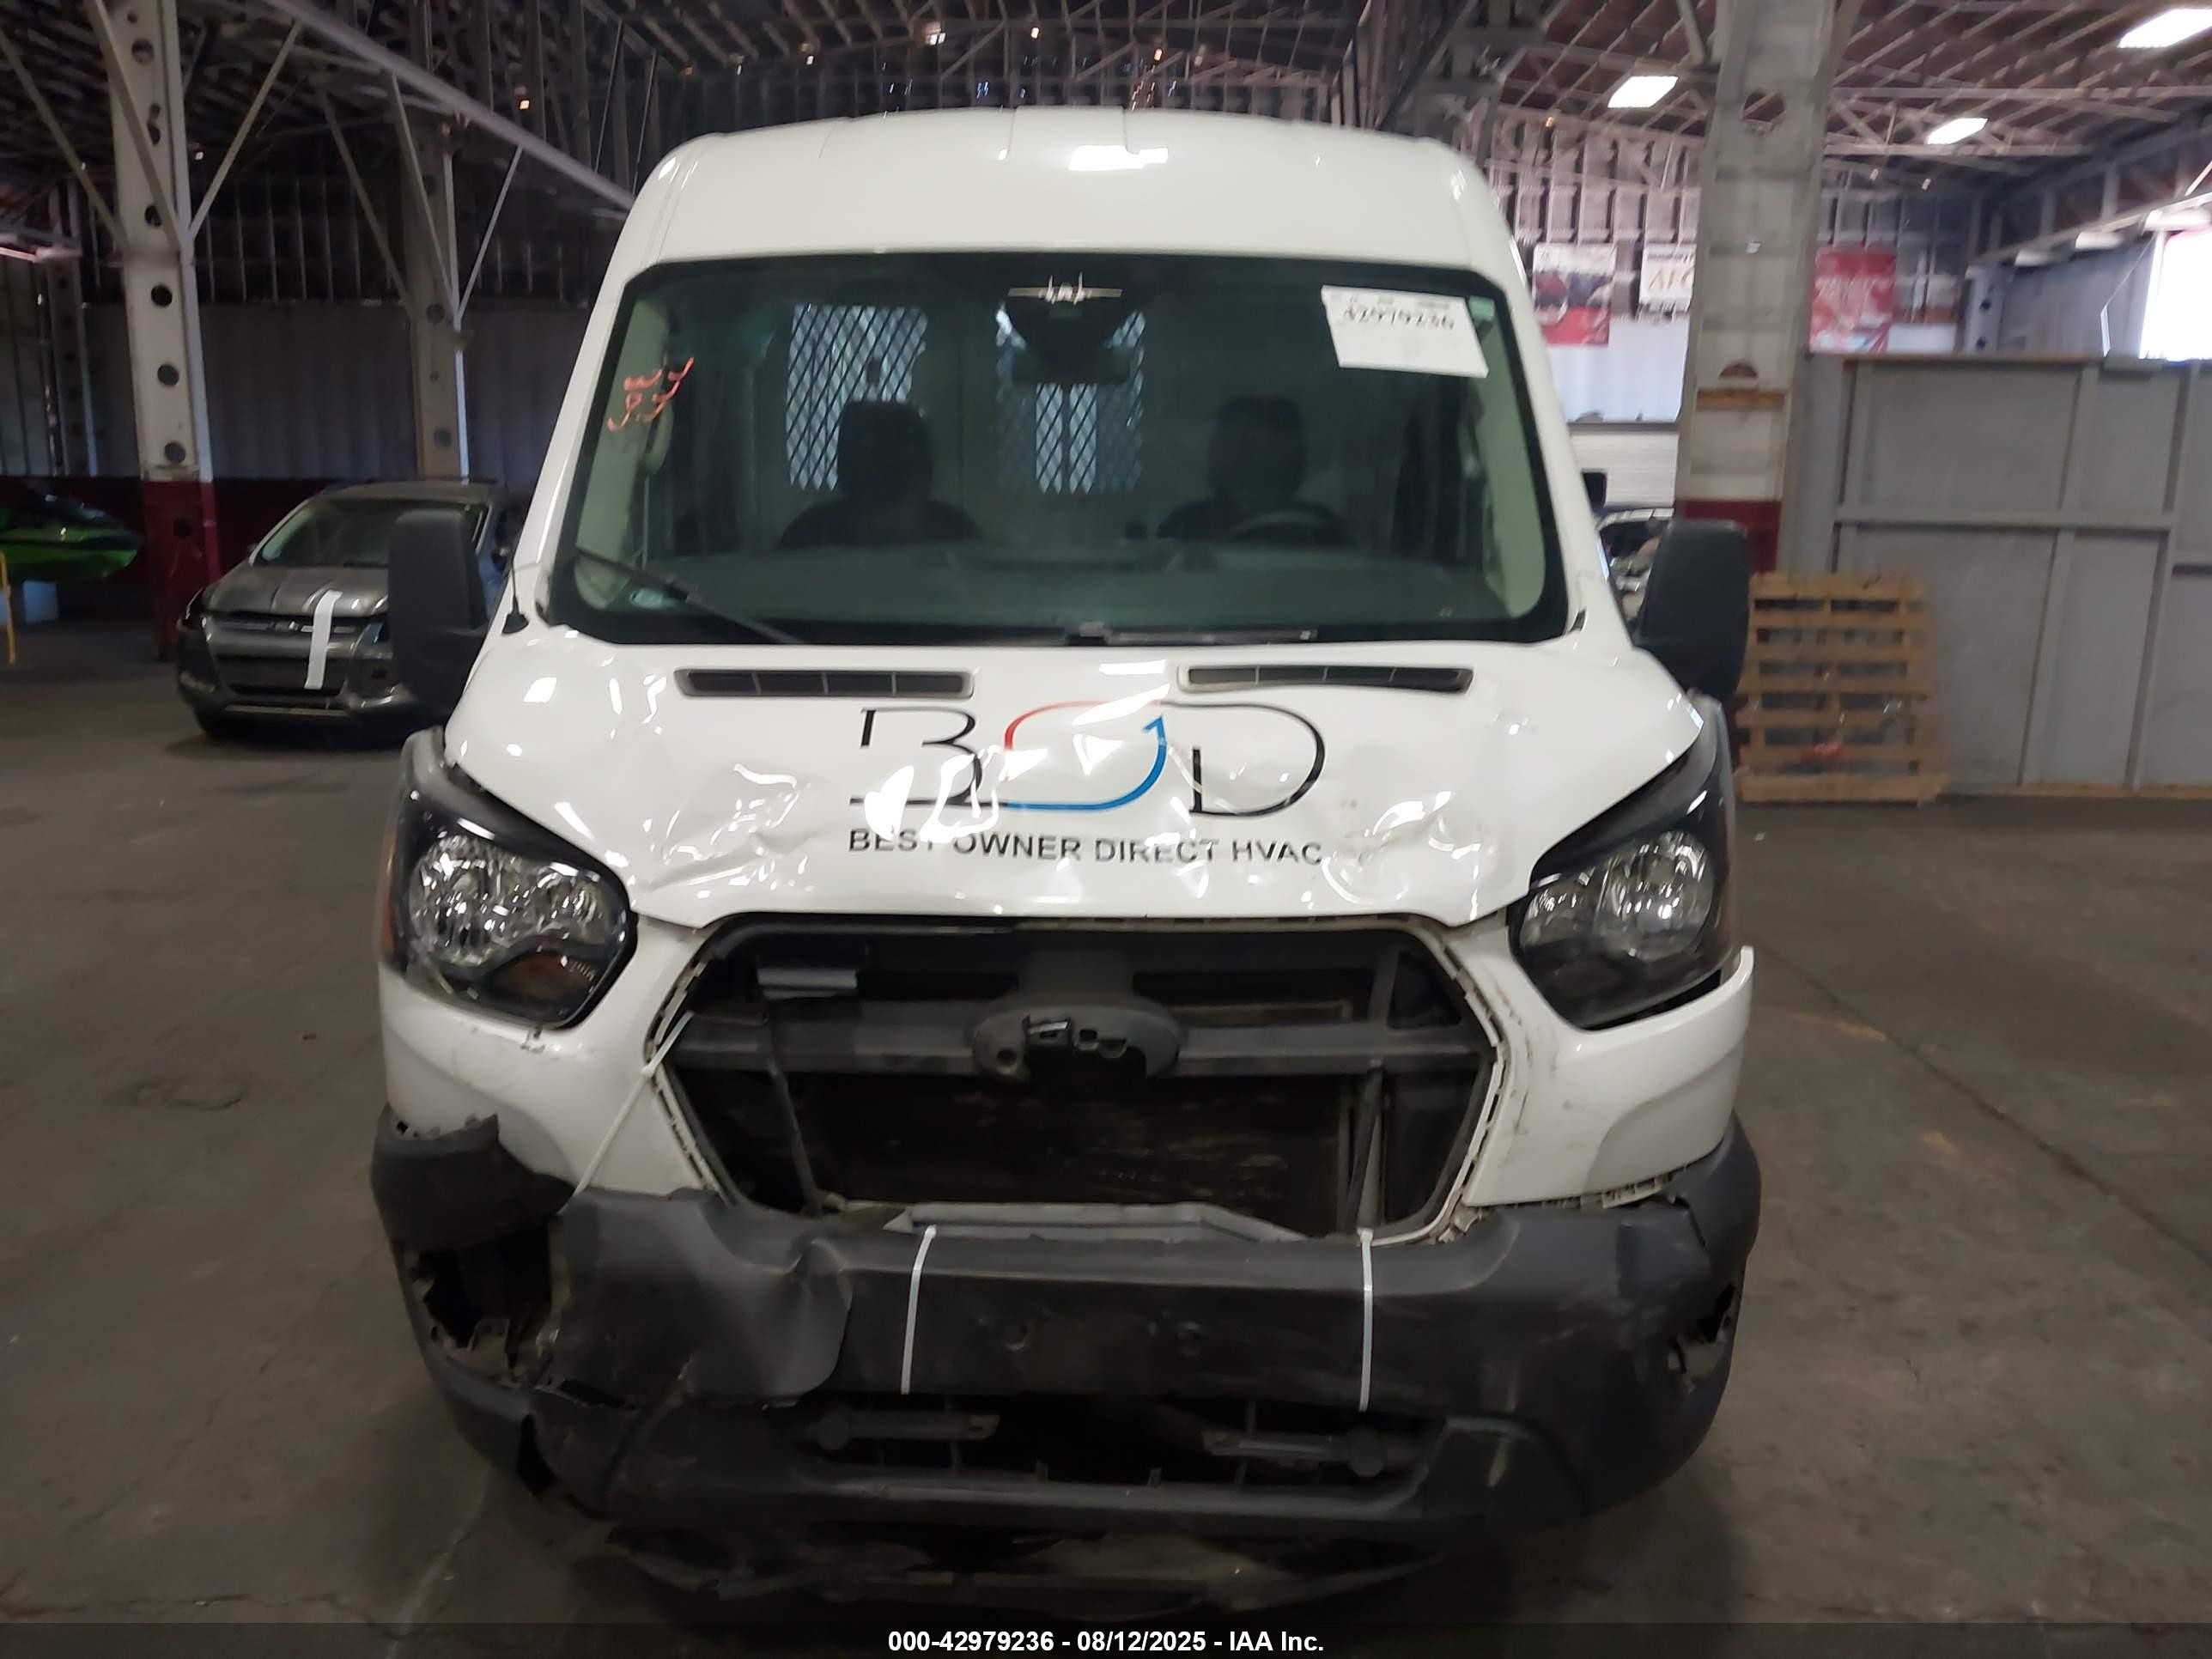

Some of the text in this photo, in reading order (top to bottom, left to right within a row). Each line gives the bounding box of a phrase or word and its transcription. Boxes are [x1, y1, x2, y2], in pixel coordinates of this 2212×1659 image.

[953, 833, 1082, 861] OWNER
[1095, 838, 1219, 864] DIRECT
[1231, 841, 1322, 866] HVAC
